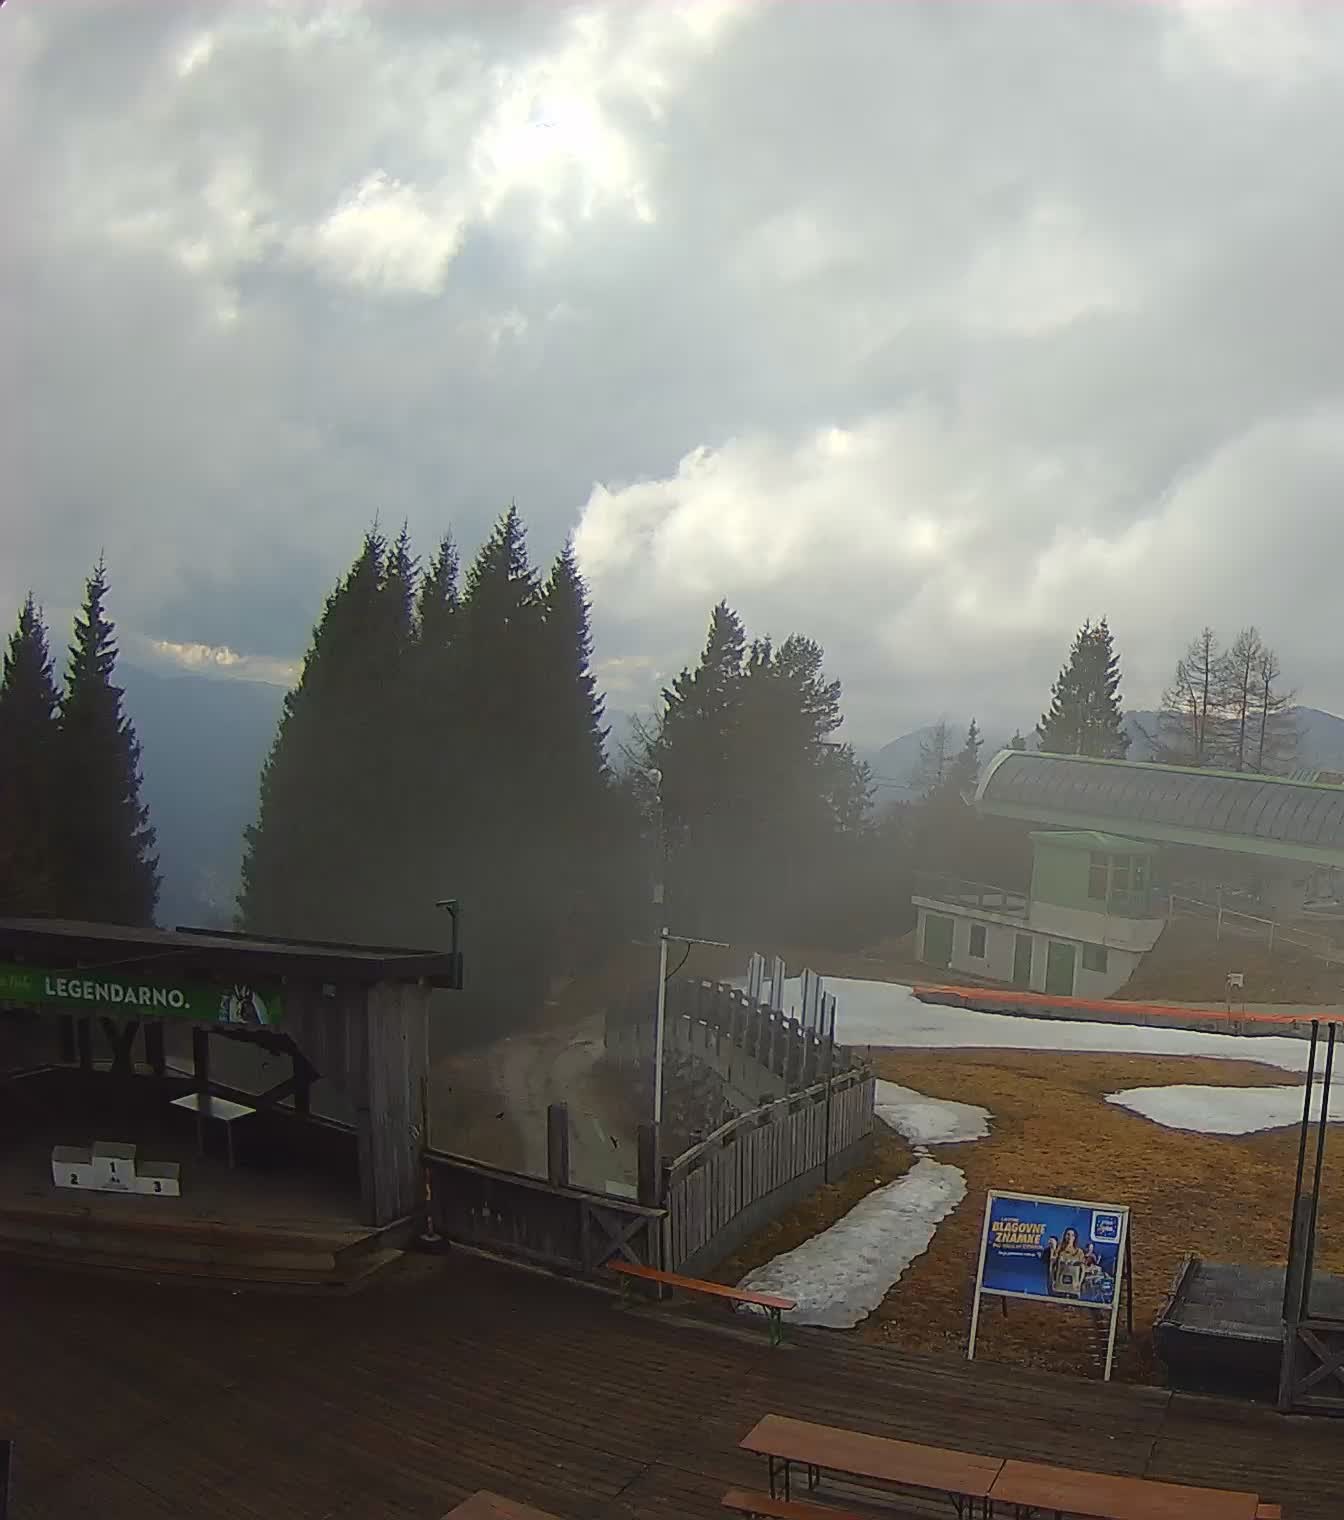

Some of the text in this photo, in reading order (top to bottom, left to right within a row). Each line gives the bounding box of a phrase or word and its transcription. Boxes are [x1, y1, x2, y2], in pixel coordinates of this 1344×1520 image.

[45, 976, 191, 1009] LEGENDARNO.
[109, 1161, 116, 1173] 1
[70, 1173, 79, 1185] 2
[153, 1181, 162, 1193] 3
[992, 1221, 1047, 1235] BLAGOVNE
[994, 1232, 1041, 1245] ZNAMKE
